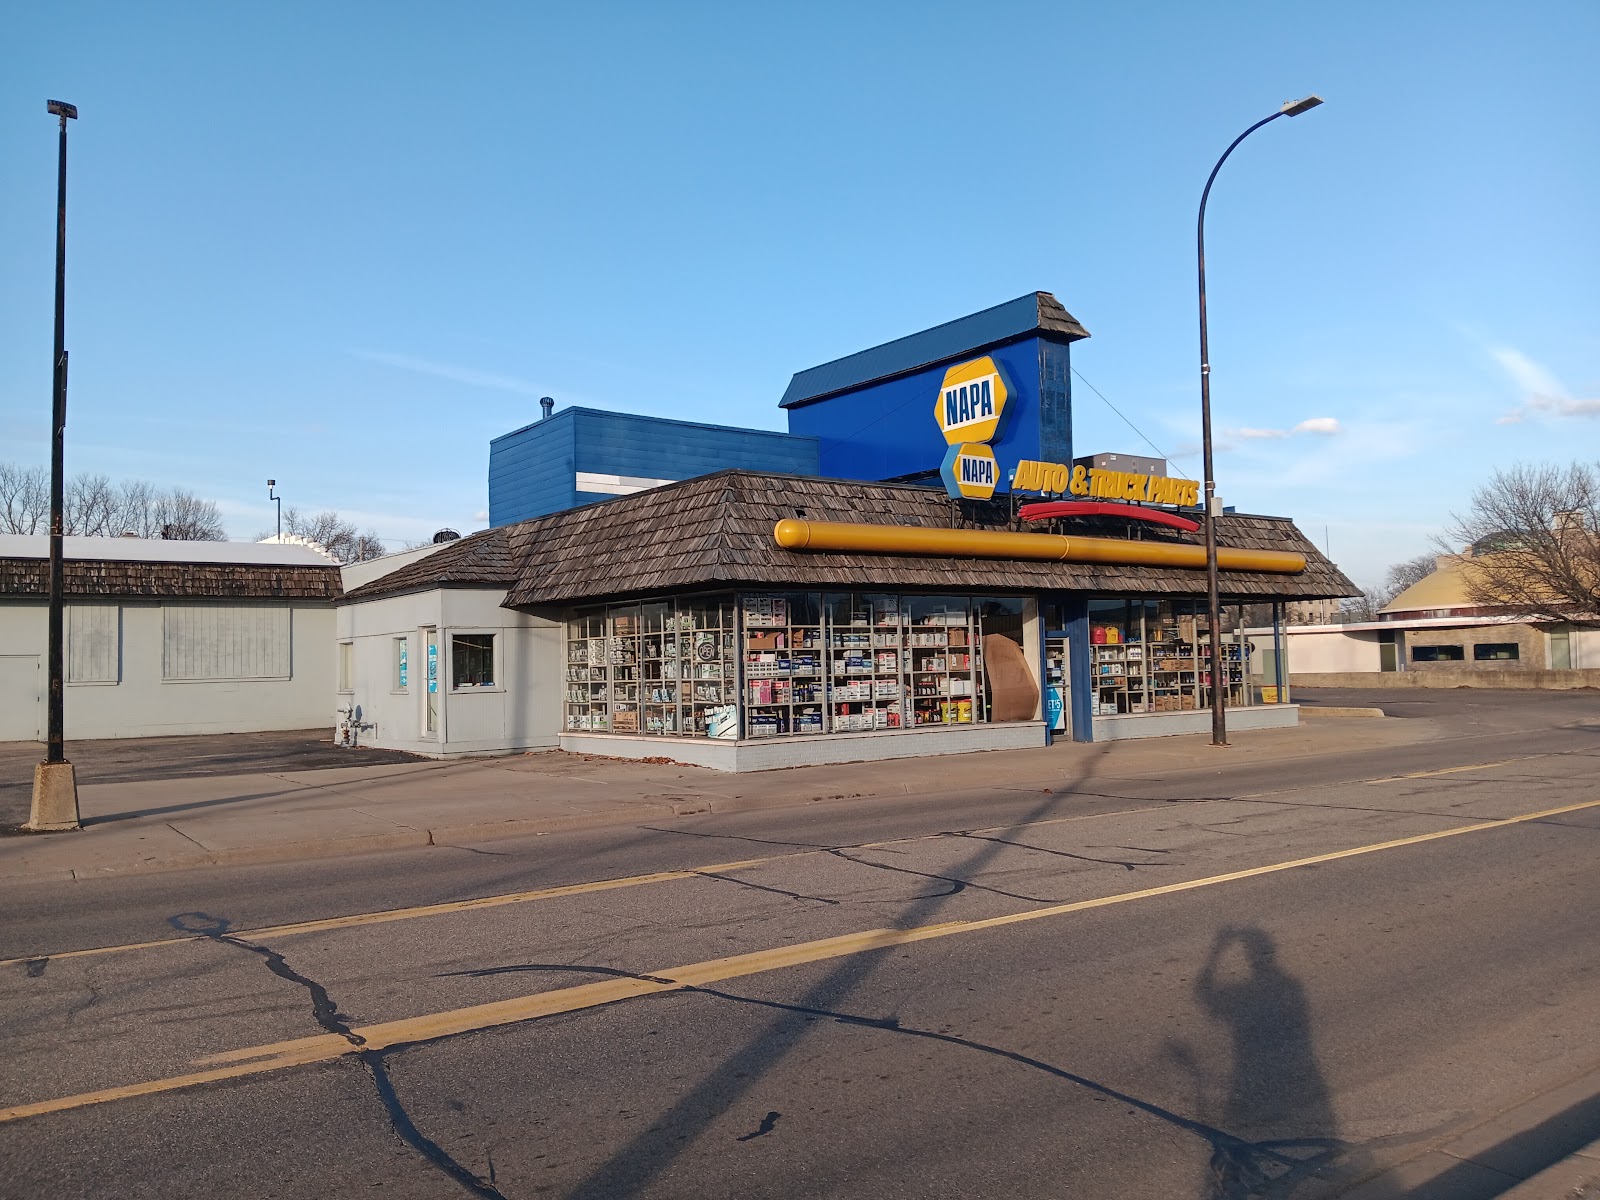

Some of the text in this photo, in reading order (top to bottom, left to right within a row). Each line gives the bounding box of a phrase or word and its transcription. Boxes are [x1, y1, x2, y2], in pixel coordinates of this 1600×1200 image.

[945, 380, 993, 426] NAPA
[962, 458, 993, 485] NAPA
[1012, 459, 1201, 508] AUTO & TRUCK PARTS
